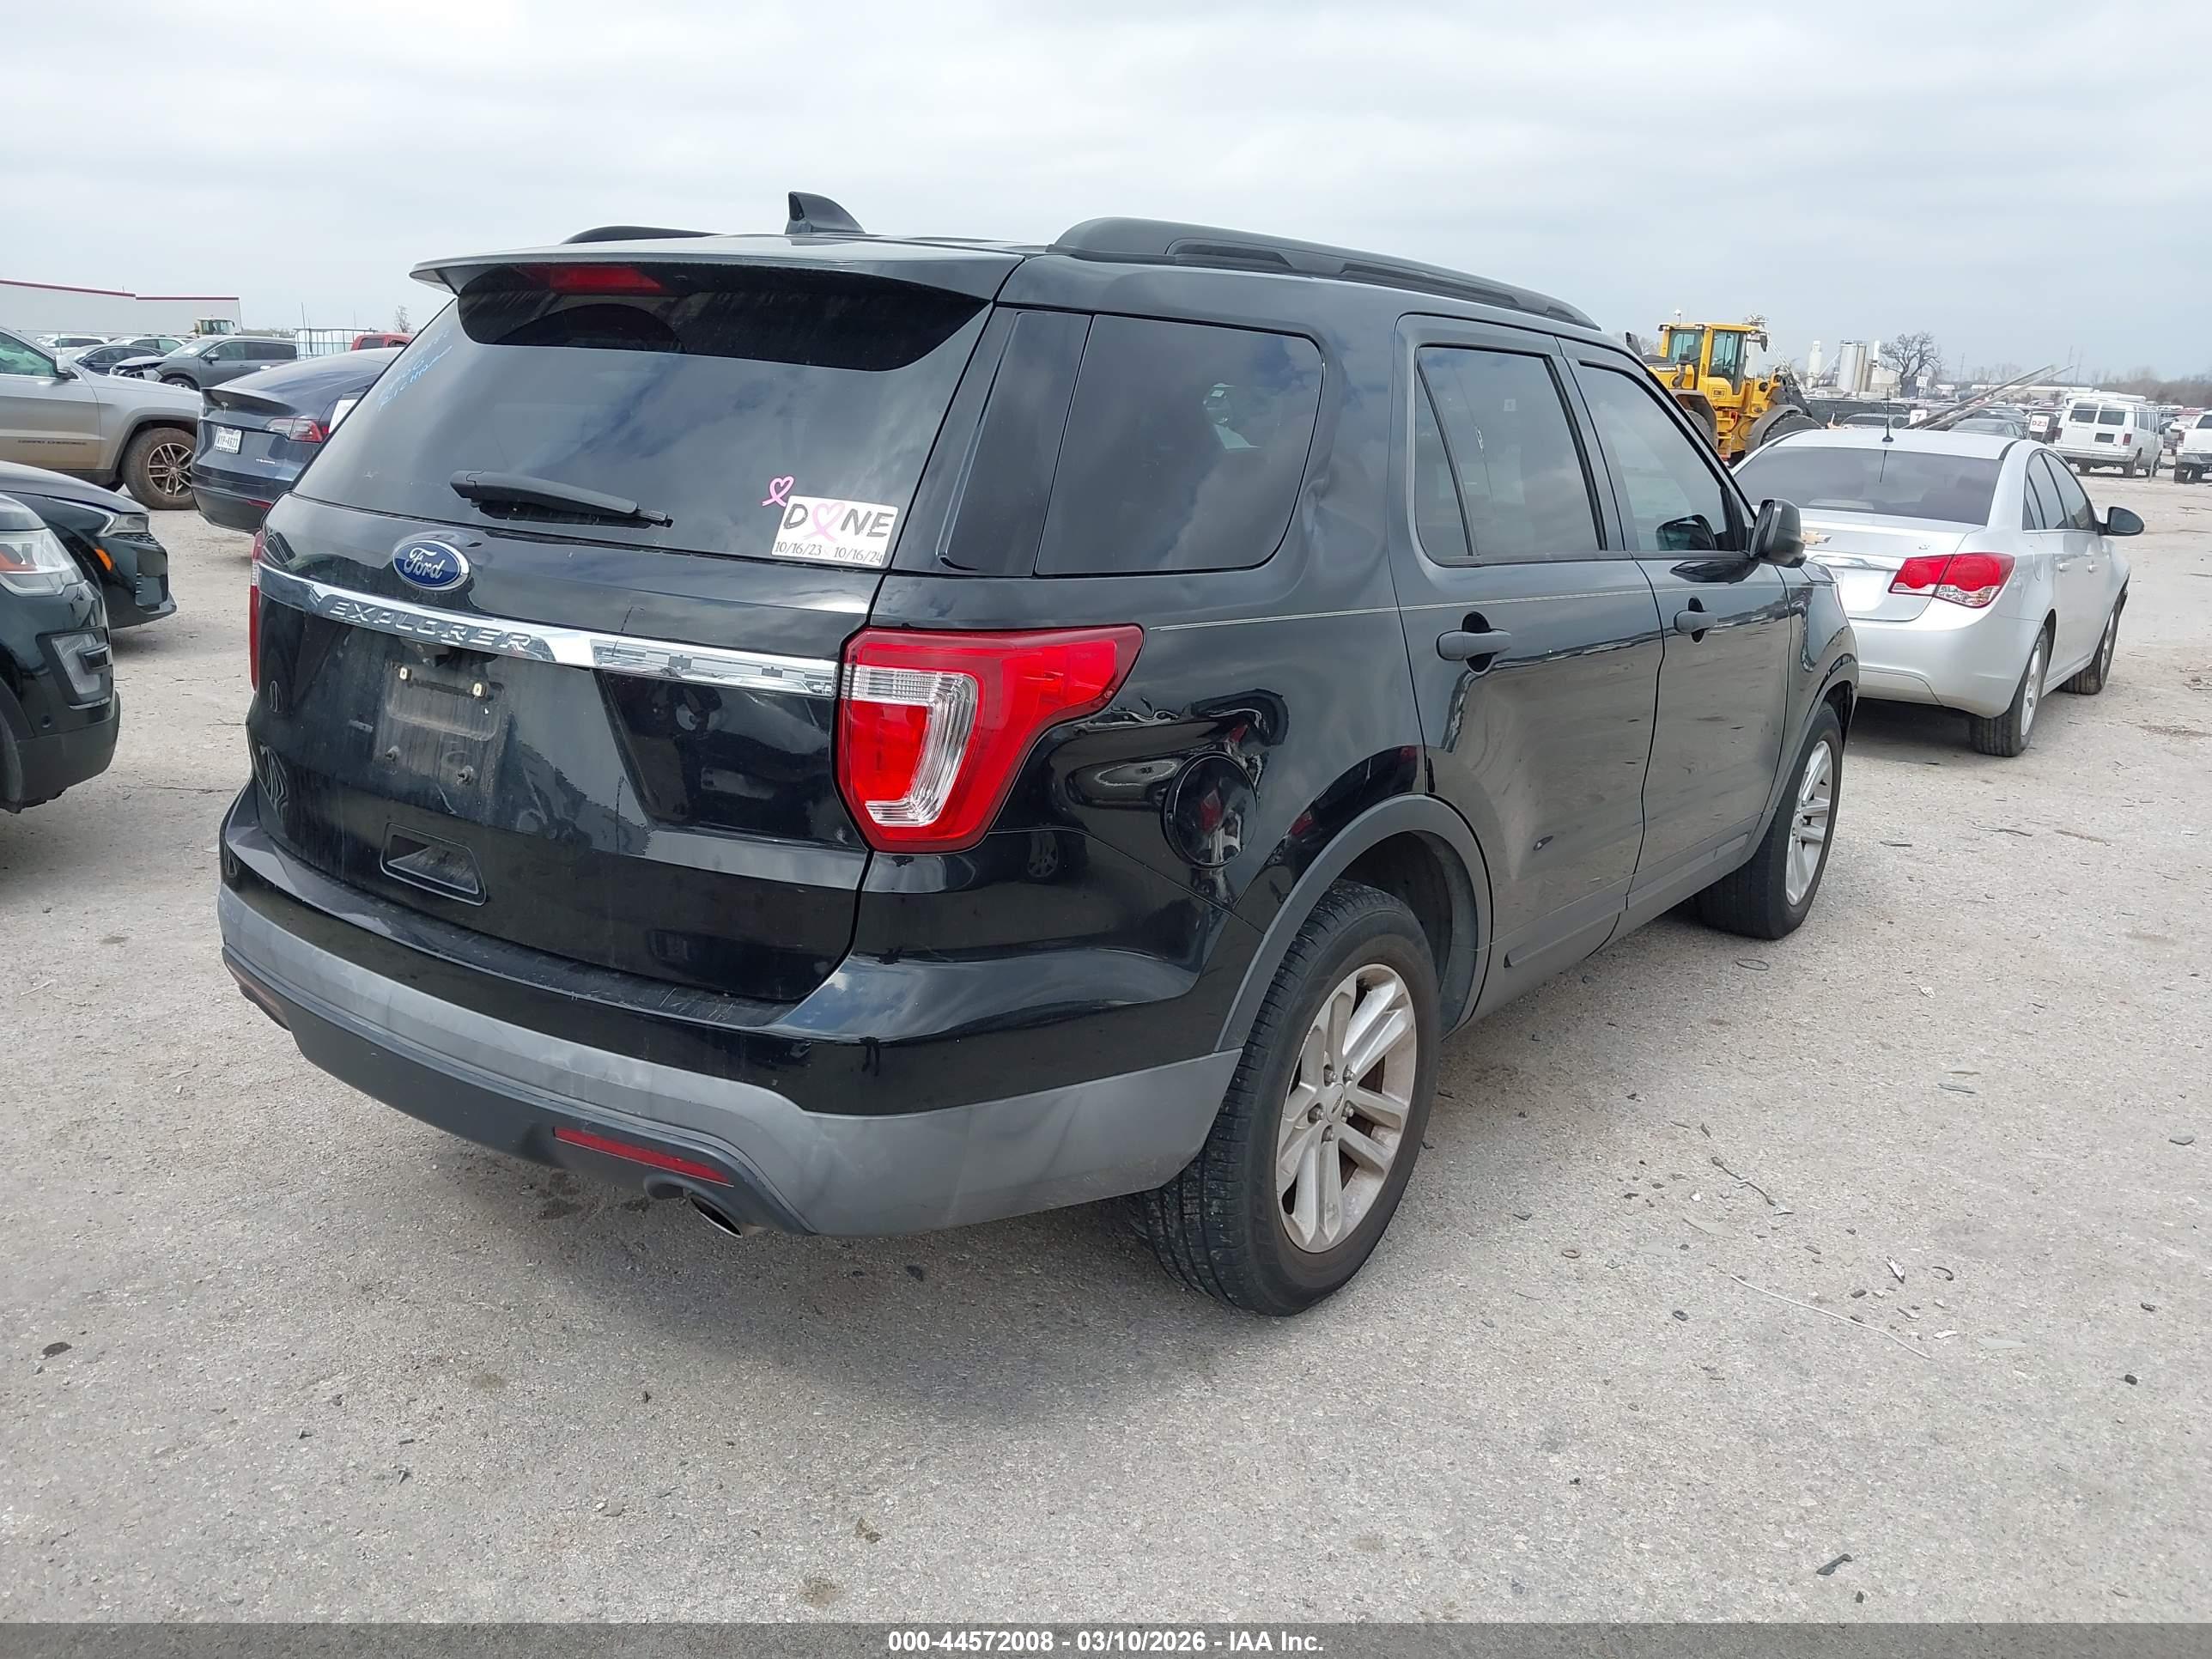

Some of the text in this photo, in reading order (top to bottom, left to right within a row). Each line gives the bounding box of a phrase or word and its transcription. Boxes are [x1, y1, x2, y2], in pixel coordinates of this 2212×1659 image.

[404, 547, 446, 580] Ford
[774, 541, 884, 564] 10/16/23 10/16/24
[329, 599, 532, 653] EXPLORER
